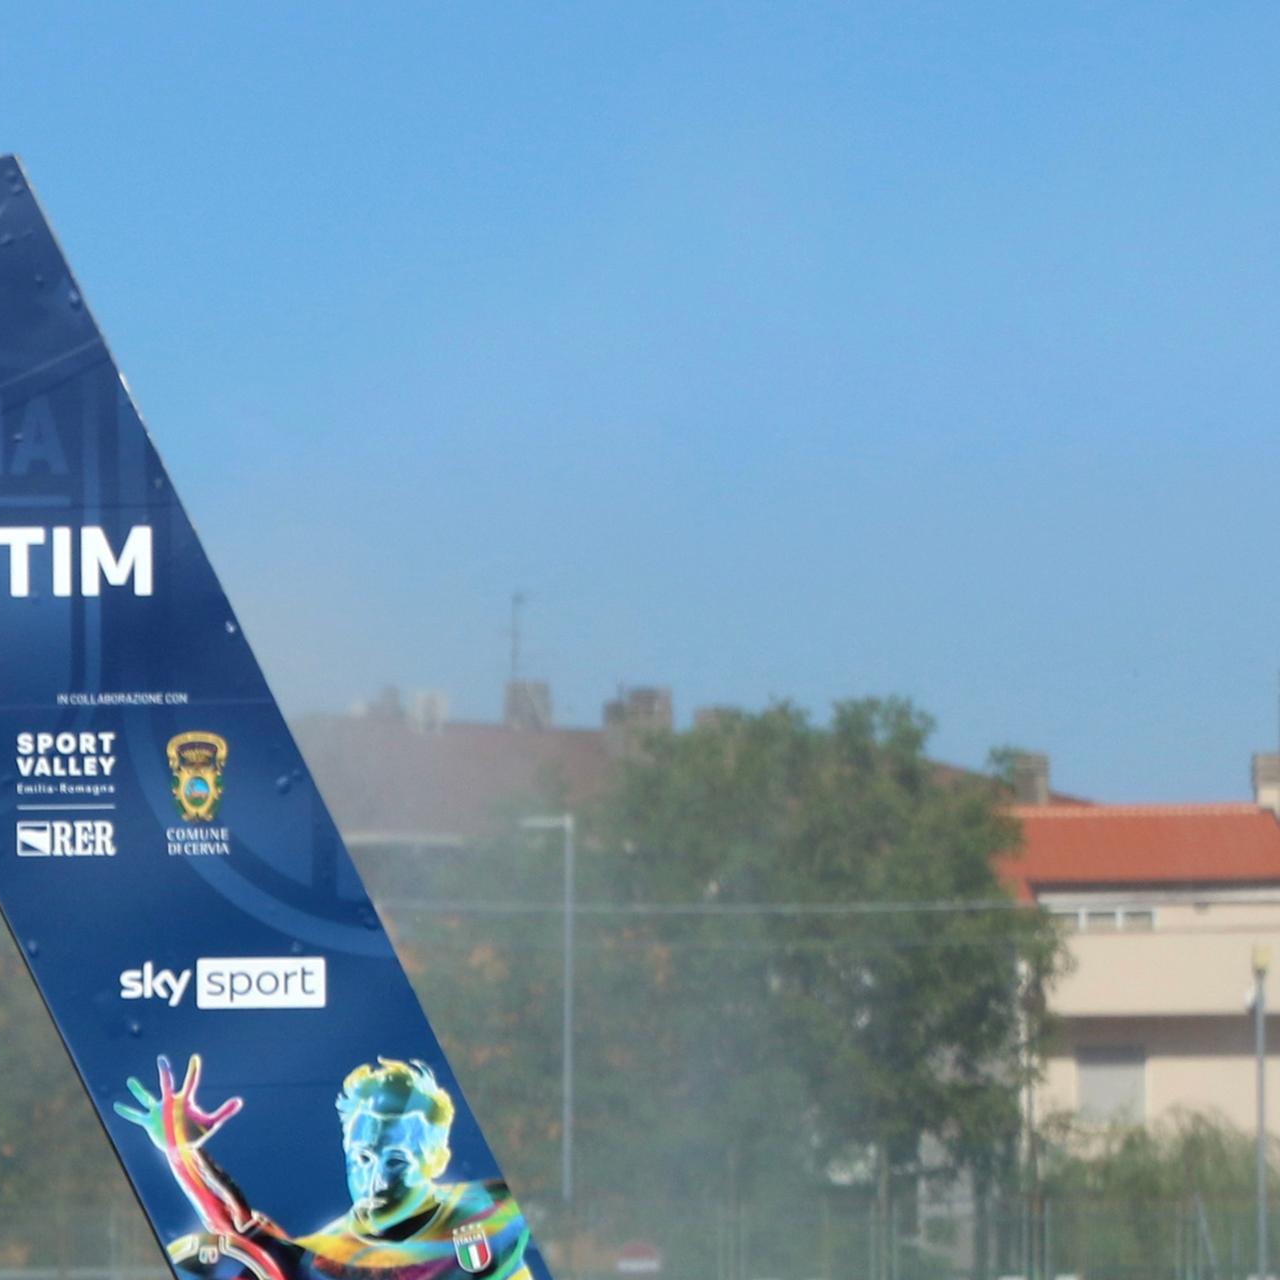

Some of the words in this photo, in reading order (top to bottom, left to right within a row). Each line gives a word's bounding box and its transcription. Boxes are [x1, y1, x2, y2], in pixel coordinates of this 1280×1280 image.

[69, 693, 163, 705] COLLABORAZIONE
[165, 692, 188, 704] CON
[17, 732, 116, 755] SPORT
[16, 756, 116, 777] VALLEY
[16, 783, 115, 796] Emilia-Romagna
[52, 820, 117, 857] RER
[166, 827, 229, 841] COMUNE
[167, 842, 182, 856] DI
[184, 842, 230, 856] CERVIA
[120, 961, 192, 1007] sky
[206, 966, 316, 1003] sport
